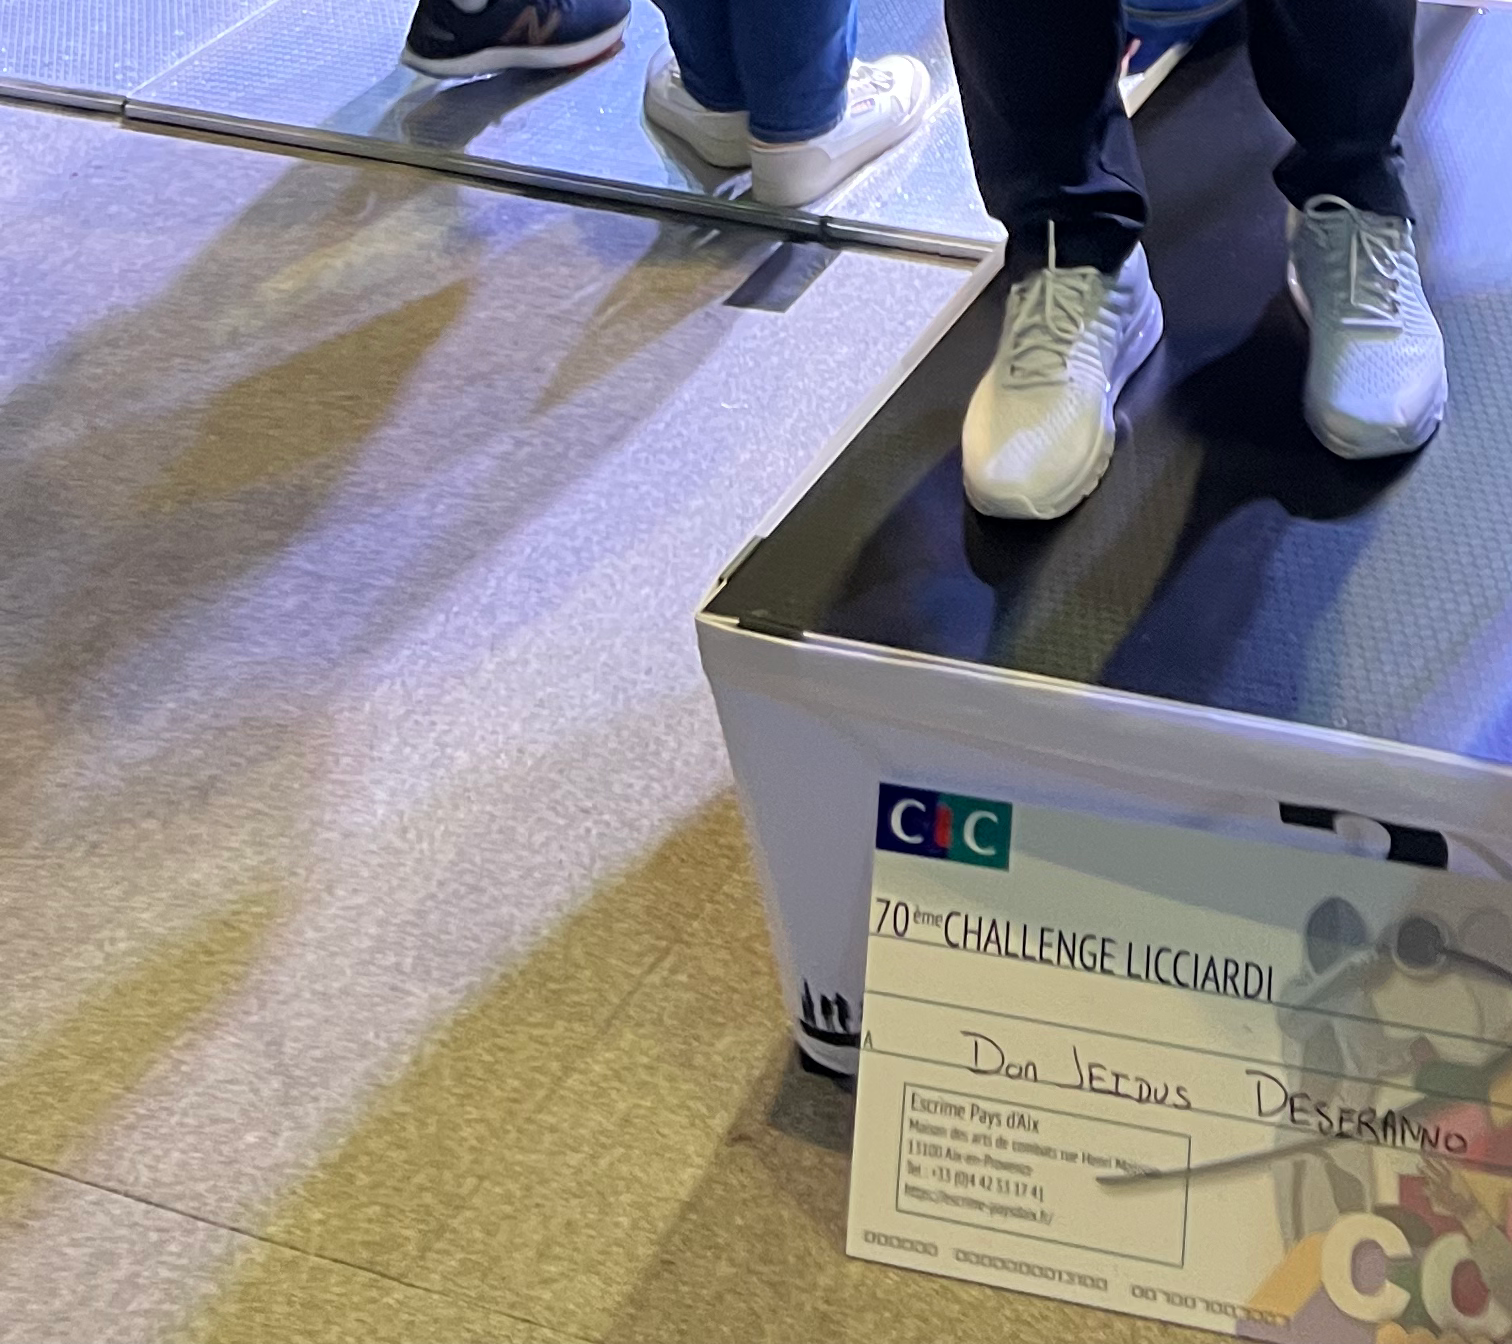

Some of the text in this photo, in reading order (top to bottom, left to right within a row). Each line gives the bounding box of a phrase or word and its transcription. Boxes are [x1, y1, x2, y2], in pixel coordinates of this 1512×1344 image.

[890, 798, 998, 856] CIC
[1127, 941, 1273, 1002] LICCIARDI
[1246, 1068, 1468, 1154] DESERANNO
